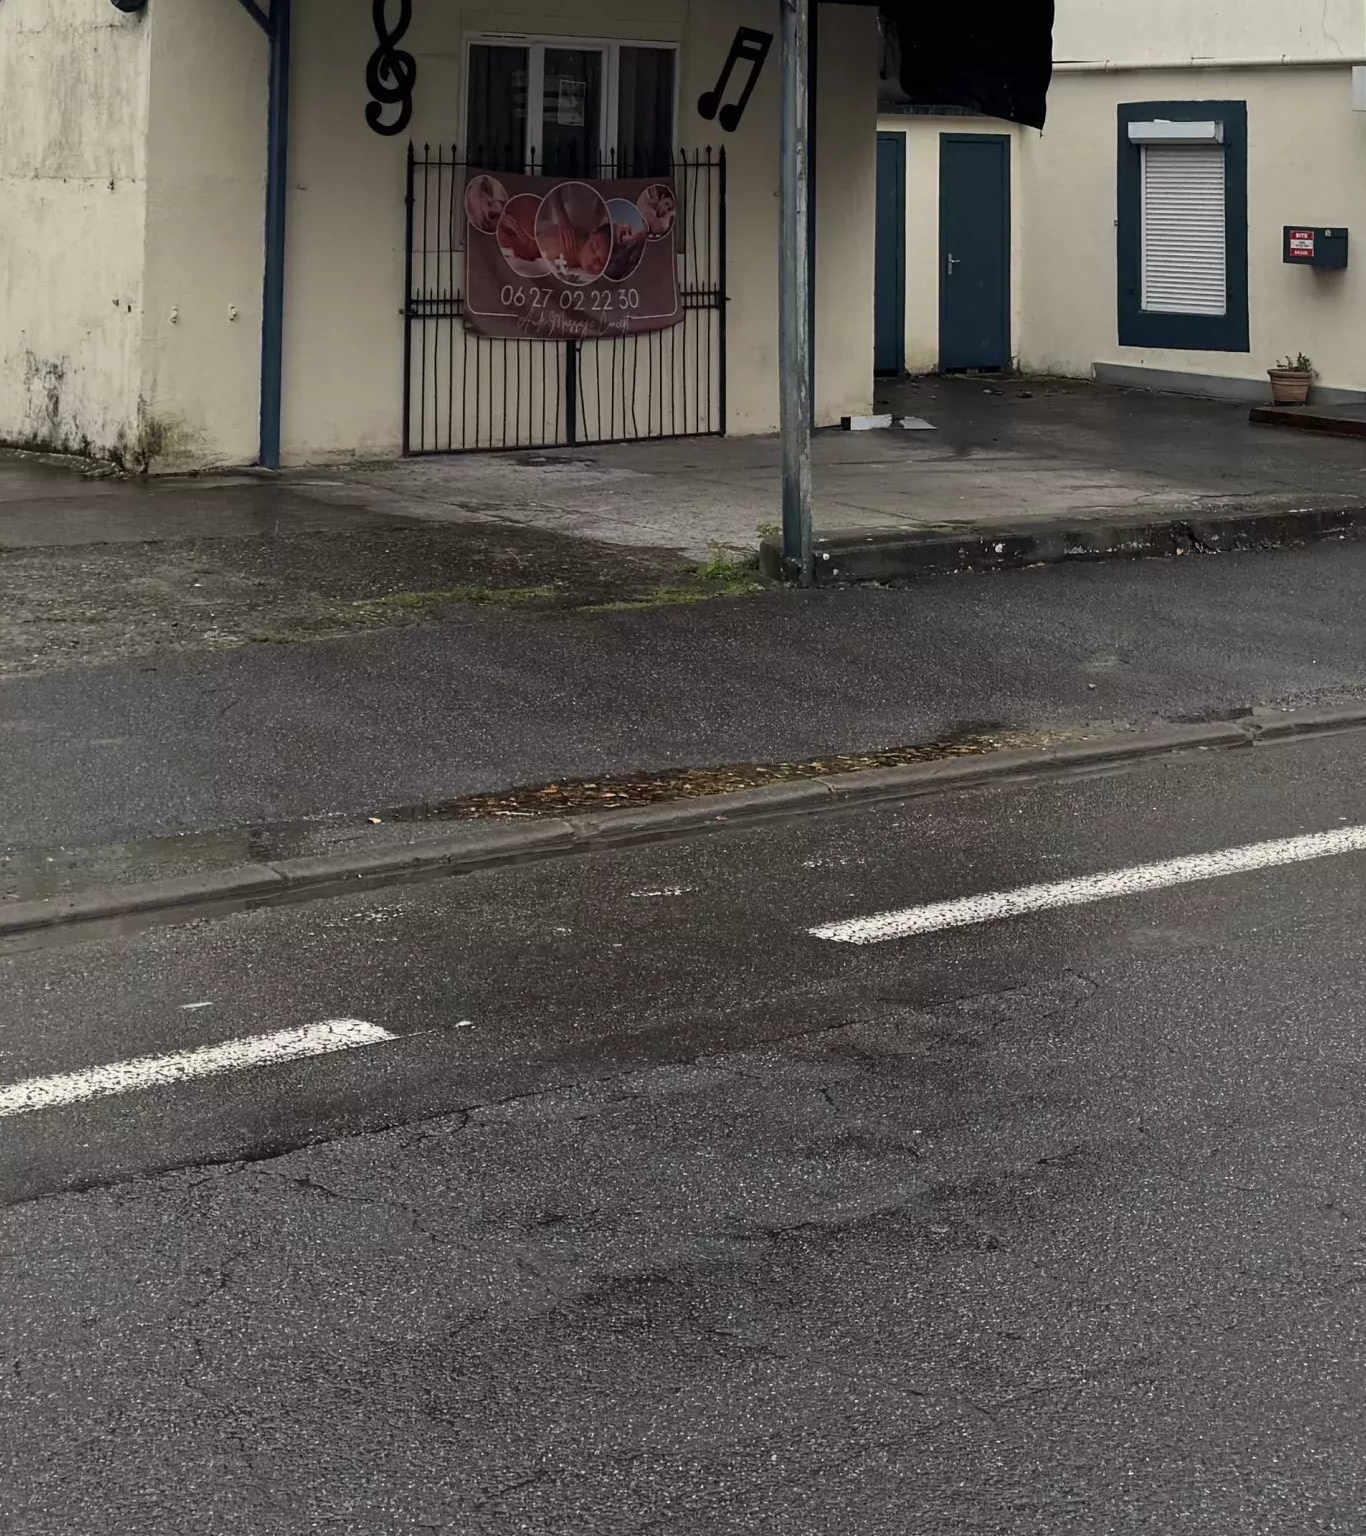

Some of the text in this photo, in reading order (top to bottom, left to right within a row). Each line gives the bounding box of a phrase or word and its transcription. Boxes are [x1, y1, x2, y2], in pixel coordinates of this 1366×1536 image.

[500, 285, 640, 311] 06 27 02 22 30
